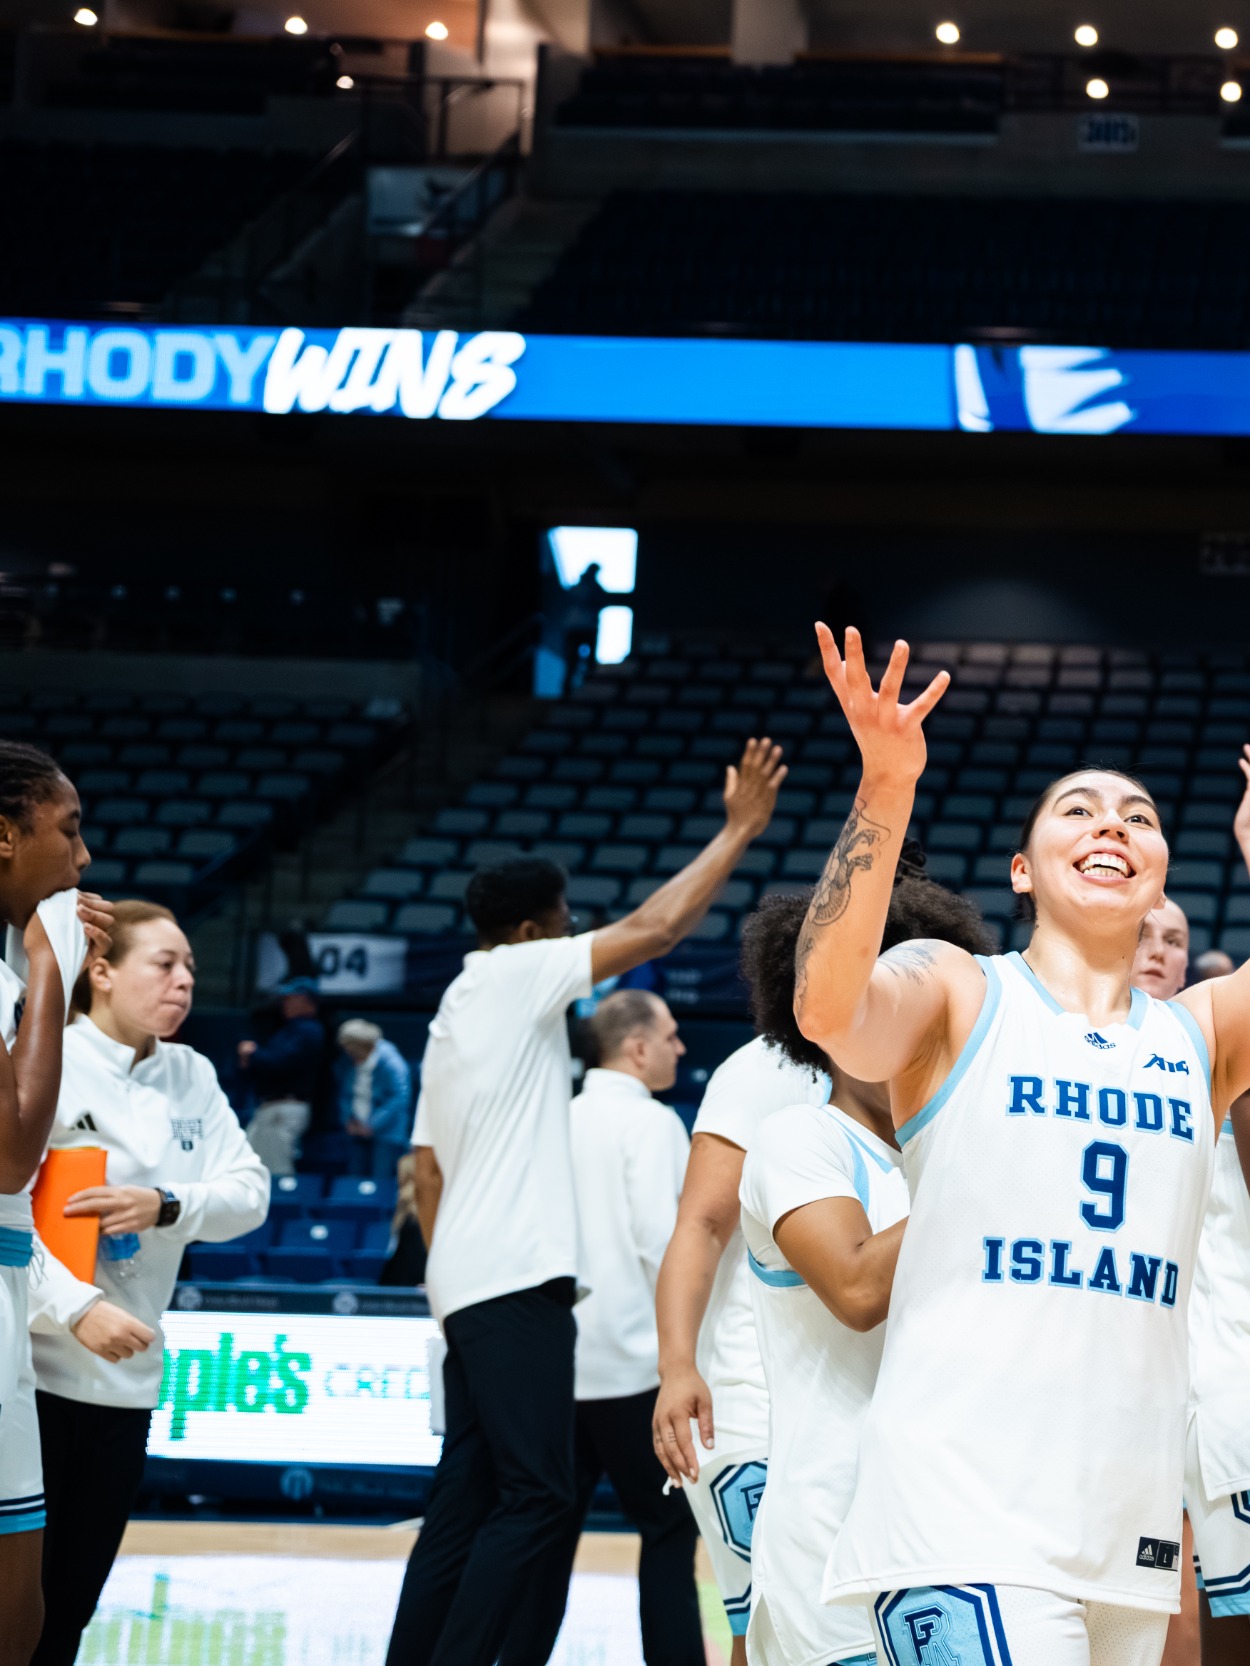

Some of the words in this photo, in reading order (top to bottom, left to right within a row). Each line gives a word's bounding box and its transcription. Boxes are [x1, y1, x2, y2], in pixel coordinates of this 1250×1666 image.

[264, 327, 526, 420] WINS
[1006, 1074, 1195, 1145] RHODE
[1079, 1138, 1129, 1233] 9
[982, 1236, 1179, 1309] ISLAND
